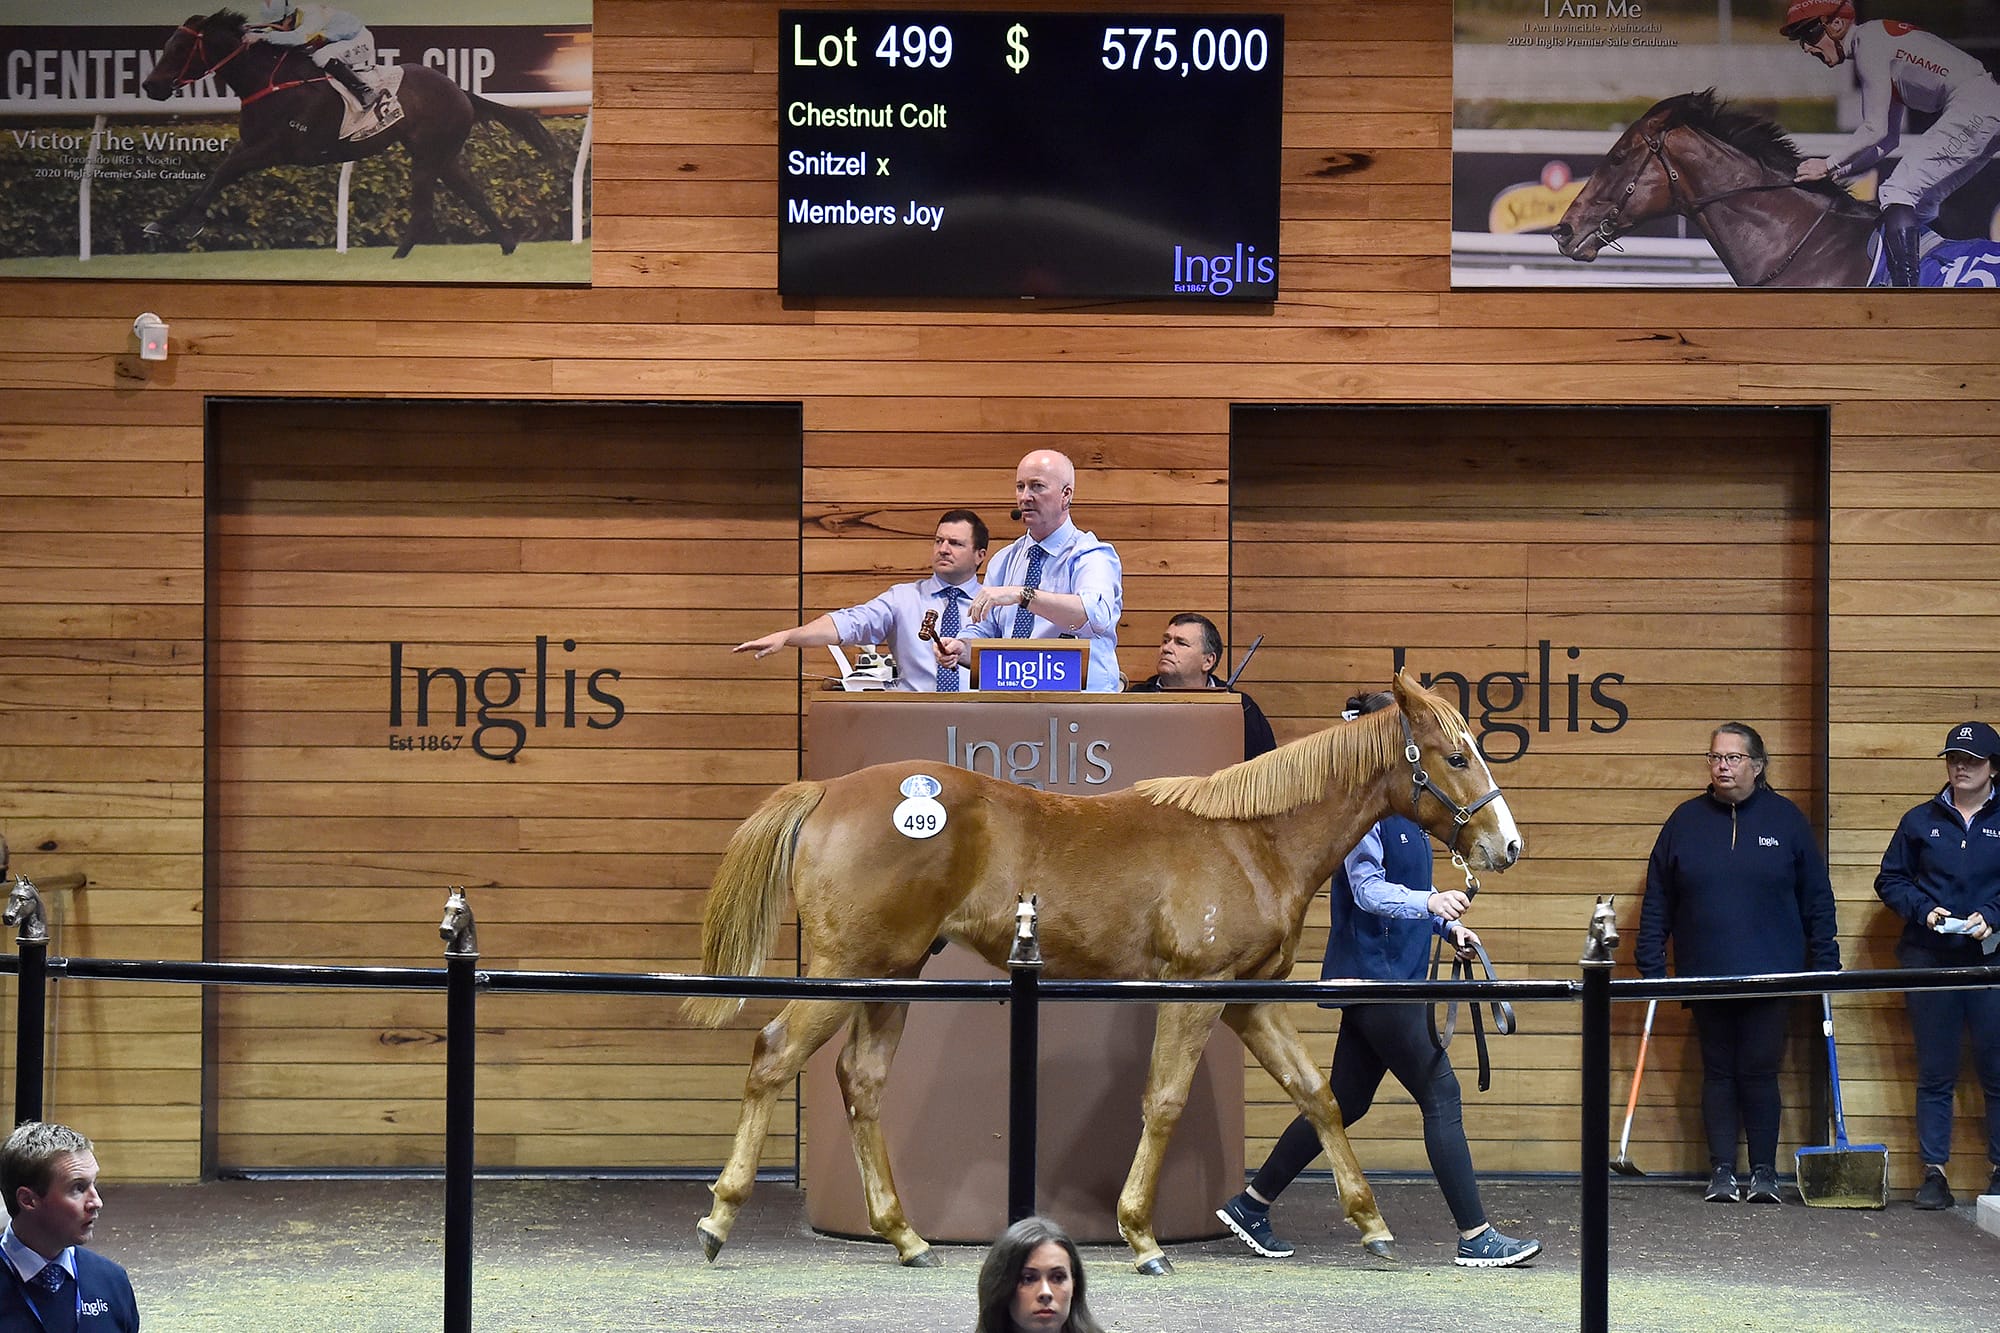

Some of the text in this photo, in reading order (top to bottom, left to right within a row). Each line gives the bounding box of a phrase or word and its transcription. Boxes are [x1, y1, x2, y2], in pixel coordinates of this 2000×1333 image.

[1543, 0, 1642, 18] I Am Me
[1533, 23, 1550, 33] Am
[1552, 23, 1600, 33] Invincible
[793, 23, 1268, 77] Lot 499 $ 575,000
[1507, 37, 1678, 49] 2020 Inglis Premier Sale Graduate
[7, 49, 238, 99] CENTEN
[788, 101, 947, 128] Chestnut Colt
[12, 129, 229, 152] Victor The Winner
[59, 155, 110, 166] (Torodo
[788, 150, 890, 176] Snitzel x
[35, 168, 207, 181] 2020 Inglis Premier Sale Graduate
[788, 198, 945, 232] Members Joy
[1174, 242, 1275, 296] Inglis
[1174, 283, 1207, 293] Est 1867
[997, 652, 1067, 690] Inglis
[388, 635, 625, 761] Inglis
[388, 734, 464, 751] Est 1867
[946, 716, 1114, 792] Inglis
[903, 814, 937, 831] 499
[80, 1298, 109, 1316] Inglis
